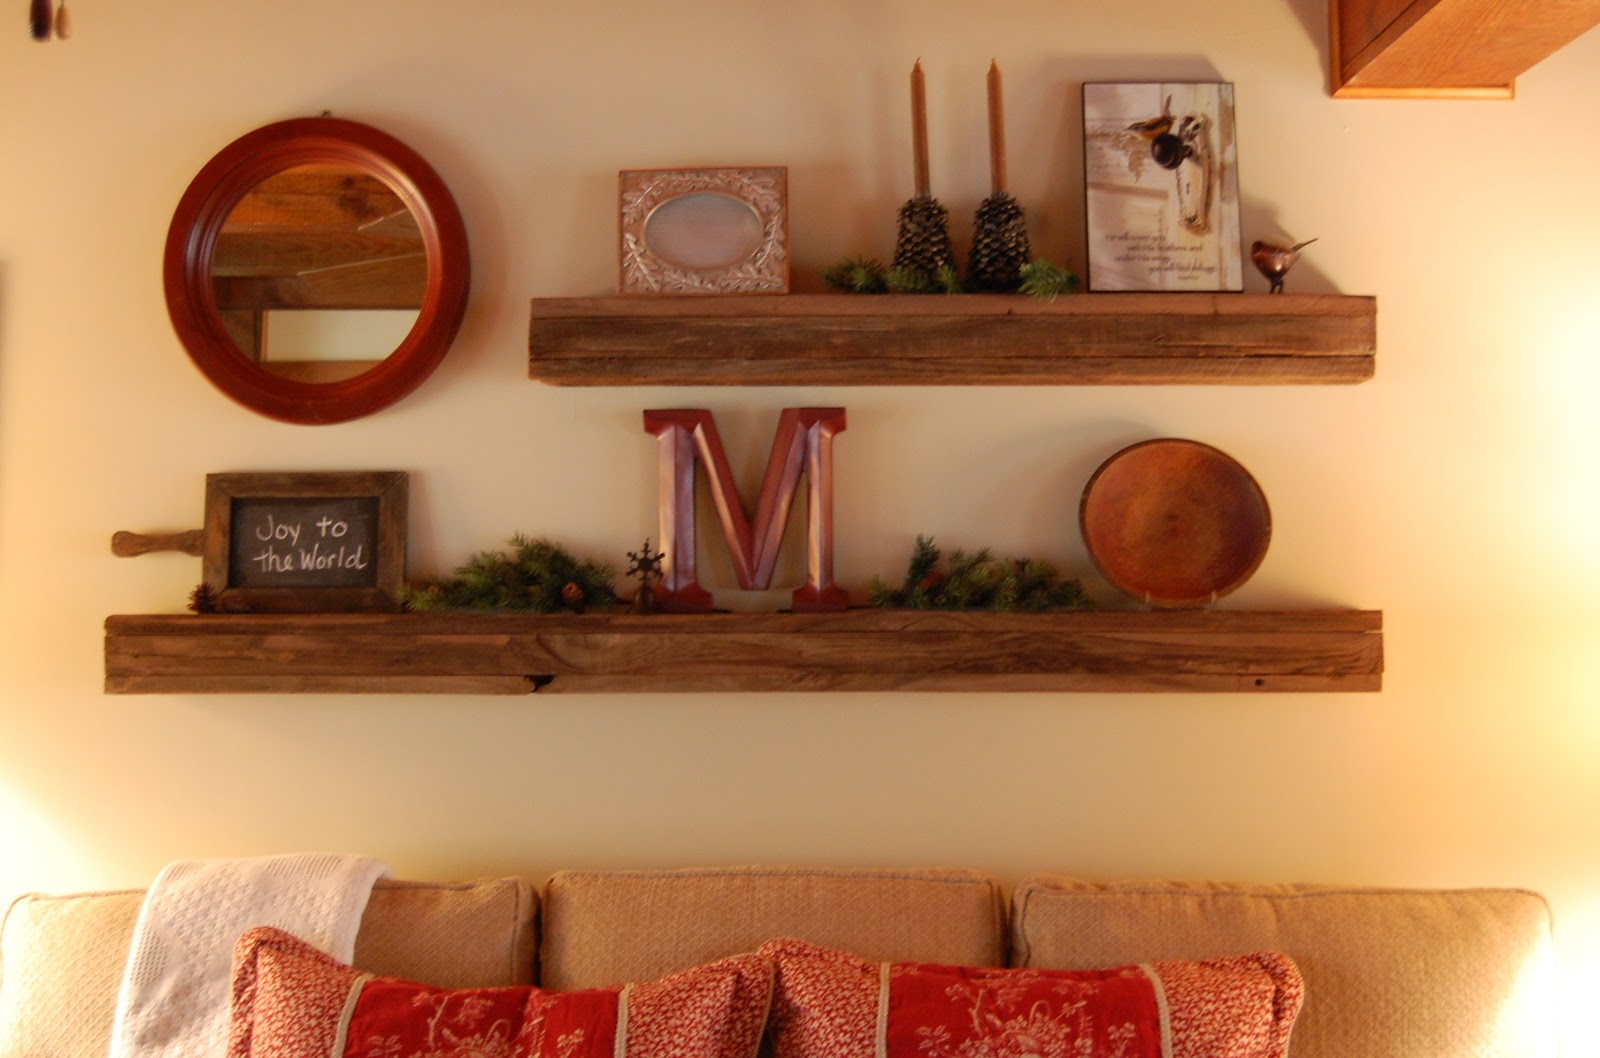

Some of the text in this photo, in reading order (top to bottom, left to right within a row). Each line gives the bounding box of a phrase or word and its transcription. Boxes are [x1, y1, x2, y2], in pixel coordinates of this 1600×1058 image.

[643, 407, 849, 613] M
[256, 514, 348, 546] Joy to
[252, 542, 367, 573] the World
